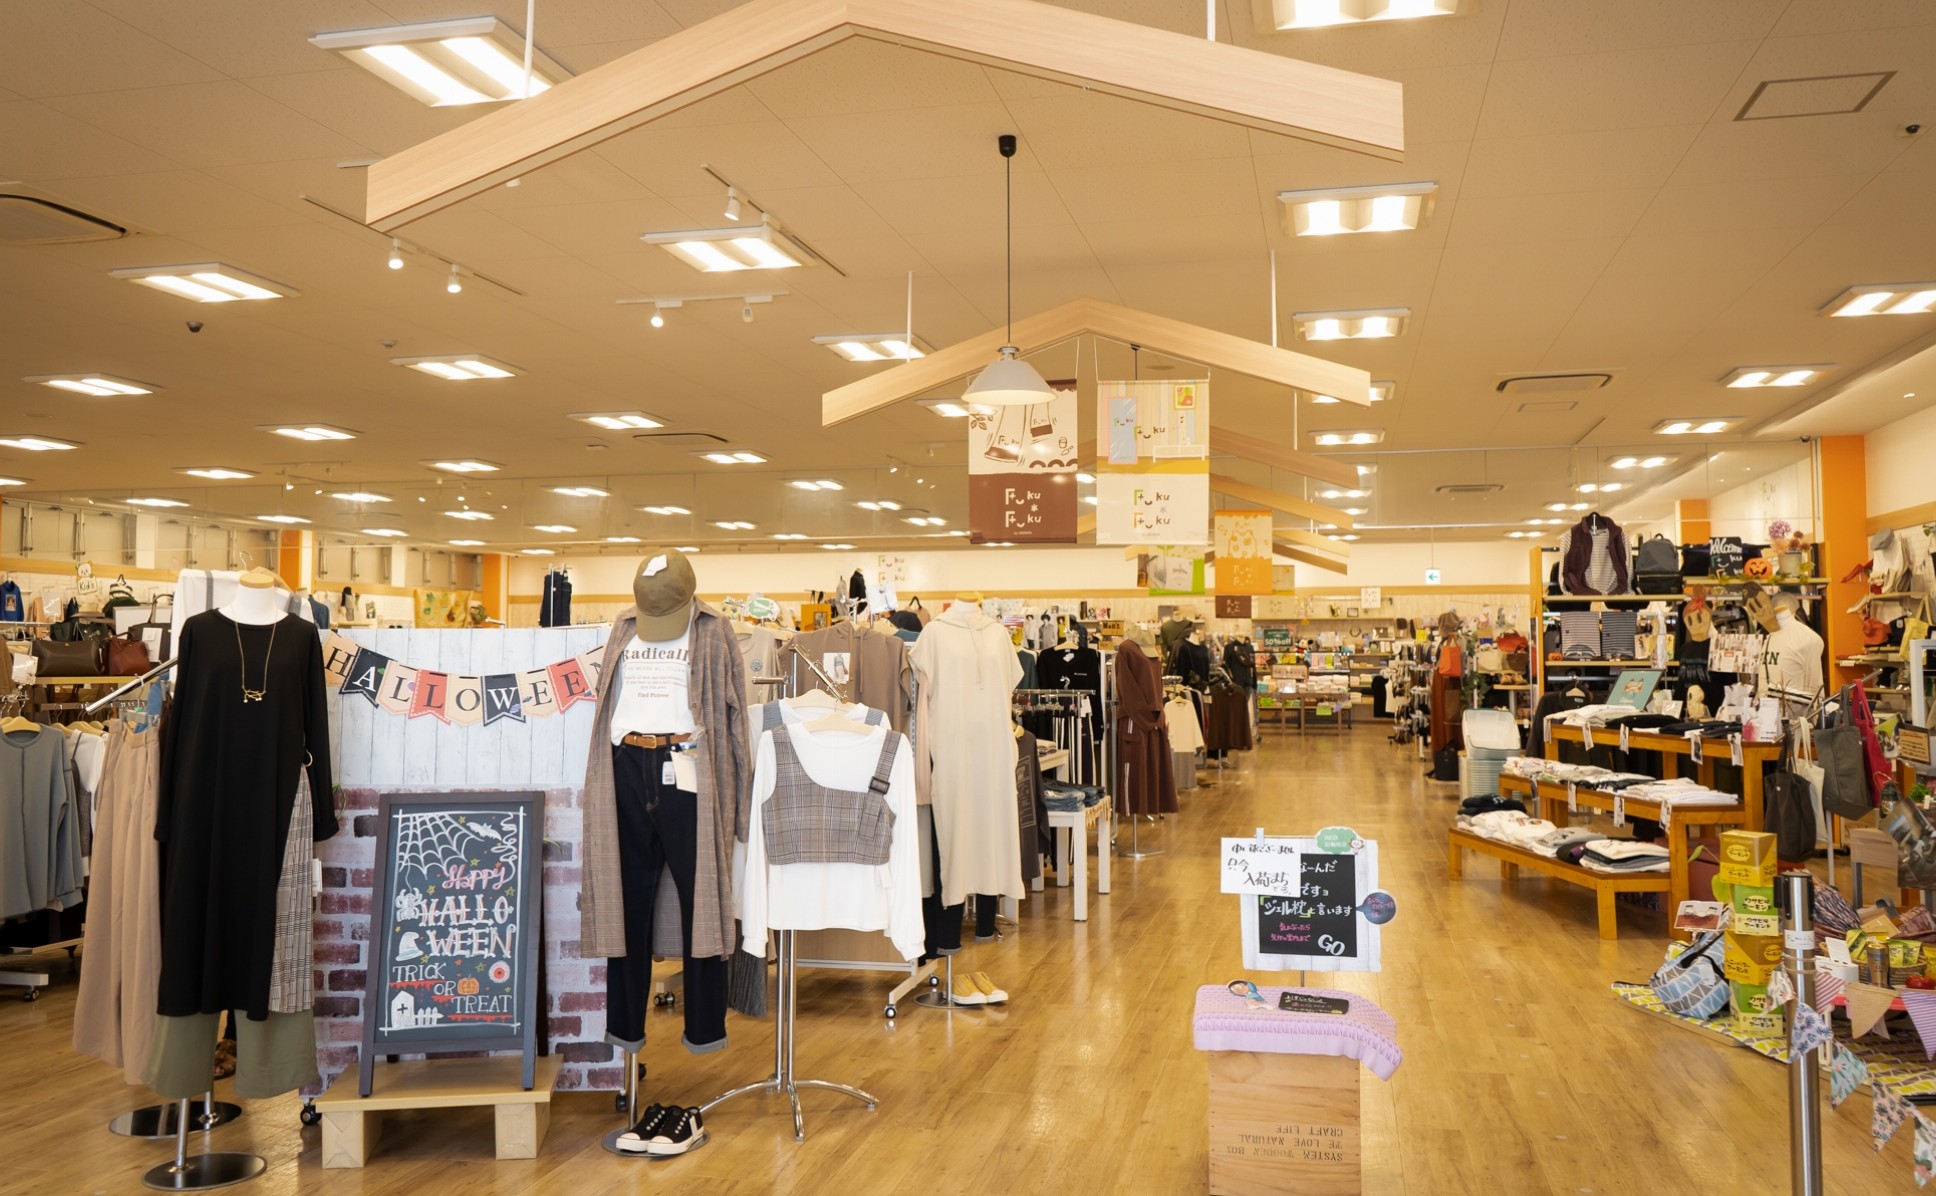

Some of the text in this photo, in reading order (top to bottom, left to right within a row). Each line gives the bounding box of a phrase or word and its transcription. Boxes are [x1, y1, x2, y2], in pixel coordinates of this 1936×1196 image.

[442, 864, 506, 890] Happy
[419, 894, 512, 927] HALLO
[426, 923, 517, 958] WEEN
[1317, 934, 1346, 956] GO
[392, 962, 447, 982] TRICK
[434, 980, 456, 996] OR
[451, 995, 512, 1013] TREAT
[1238, 1134, 1285, 1145] NATURAL
[1276, 1125, 1343, 1137] CRAFT LIFE
[1294, 1138, 1320, 1148] LOVE
